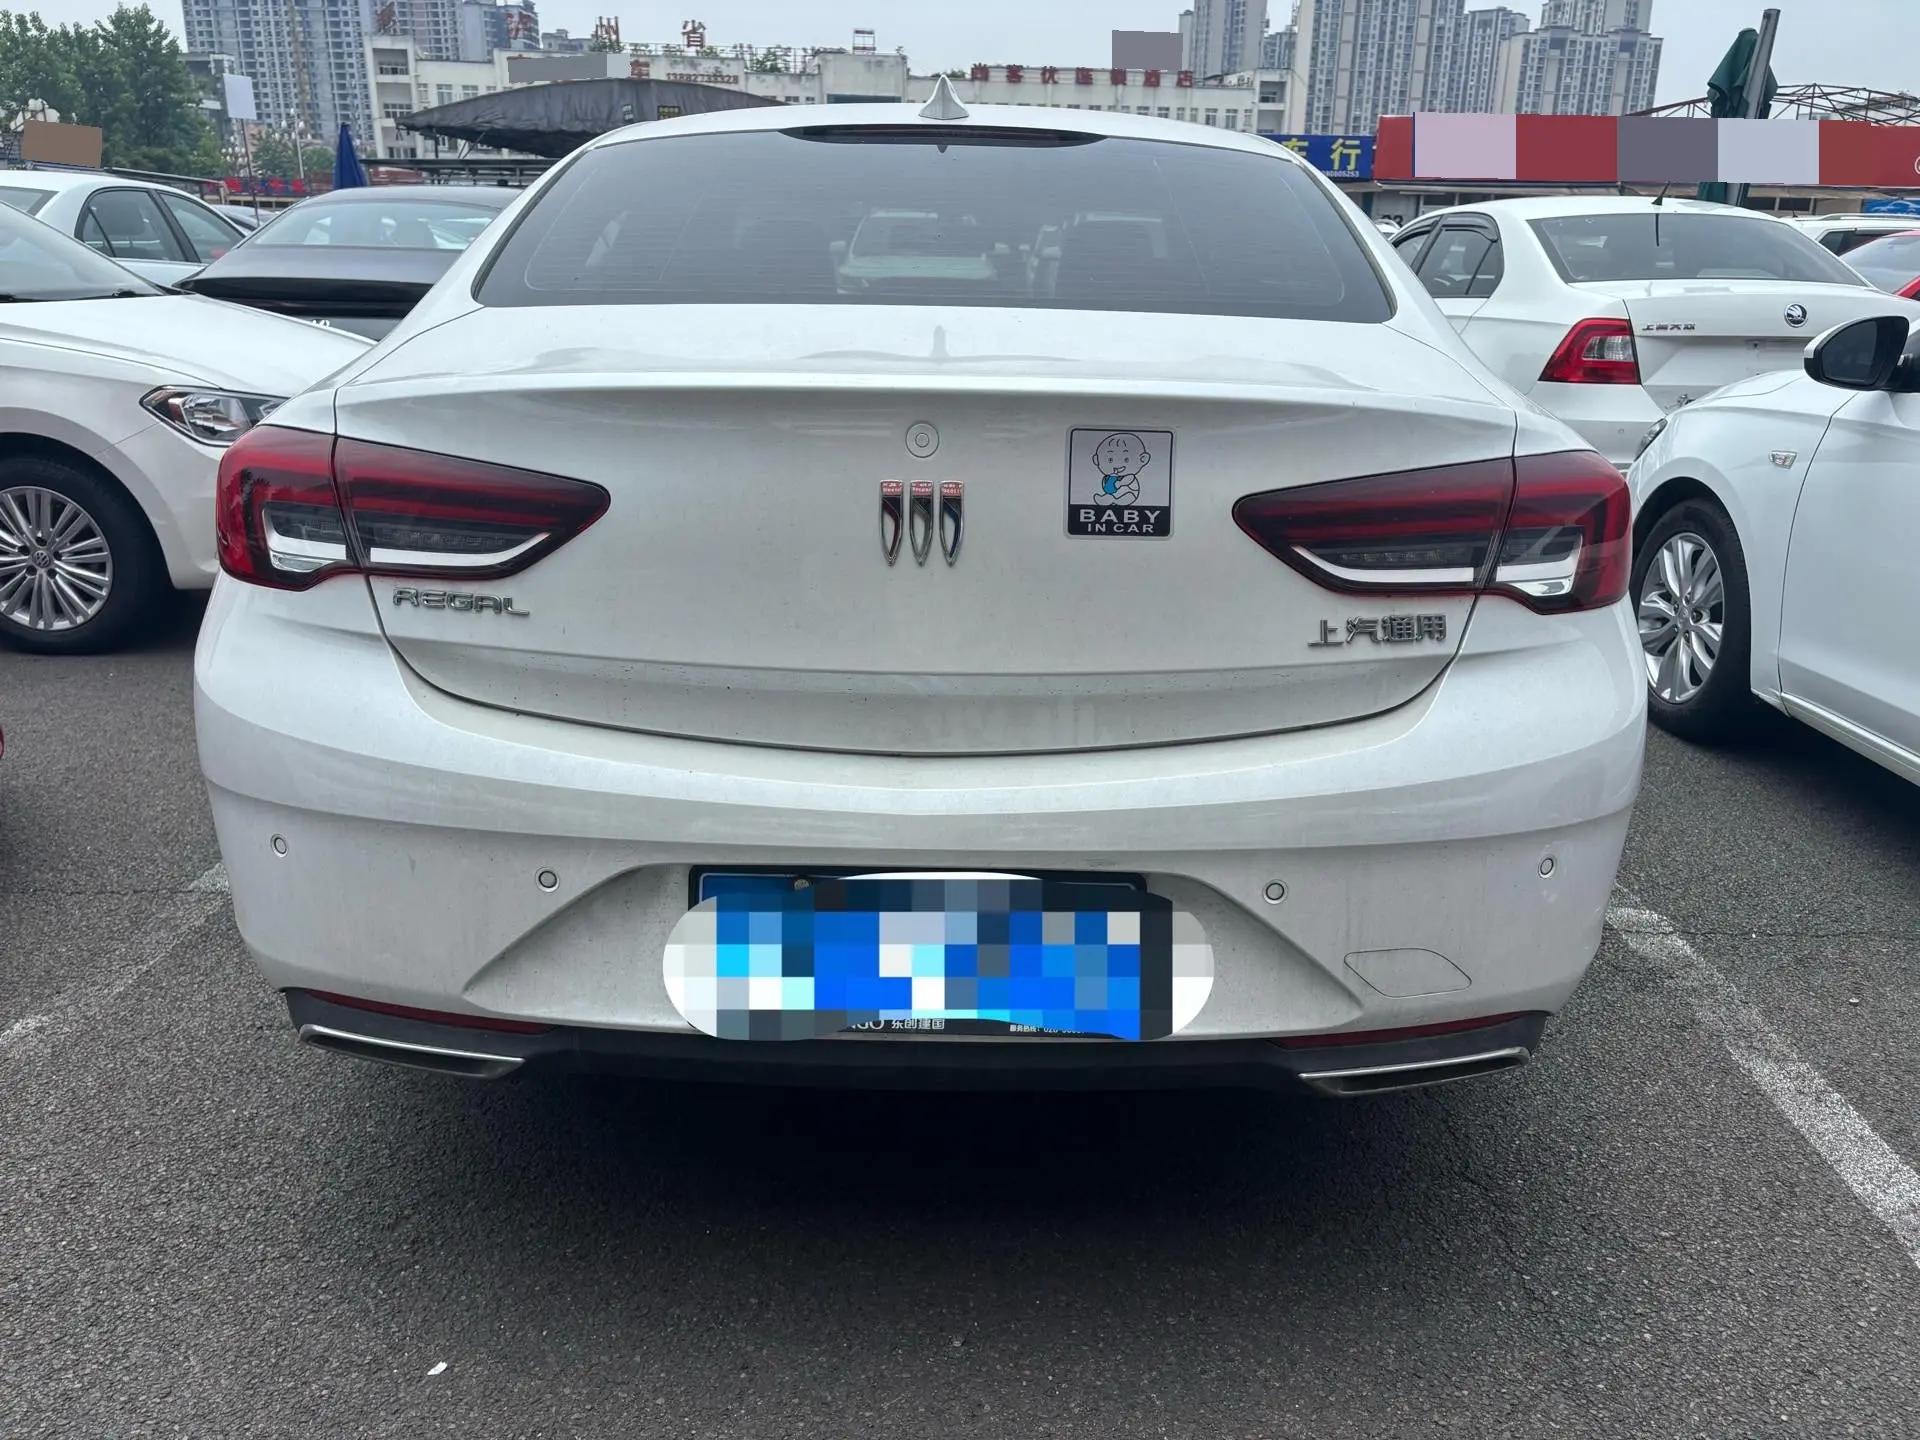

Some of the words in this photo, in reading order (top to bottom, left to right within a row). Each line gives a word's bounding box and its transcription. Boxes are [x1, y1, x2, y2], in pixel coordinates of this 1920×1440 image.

[1079, 509, 1161, 523] BABY
[1087, 523, 1106, 532] IN
[1113, 523, 1154, 533] CAR
[392, 587, 531, 617] REGAL
[1308, 613, 1447, 647] 上汽通用
